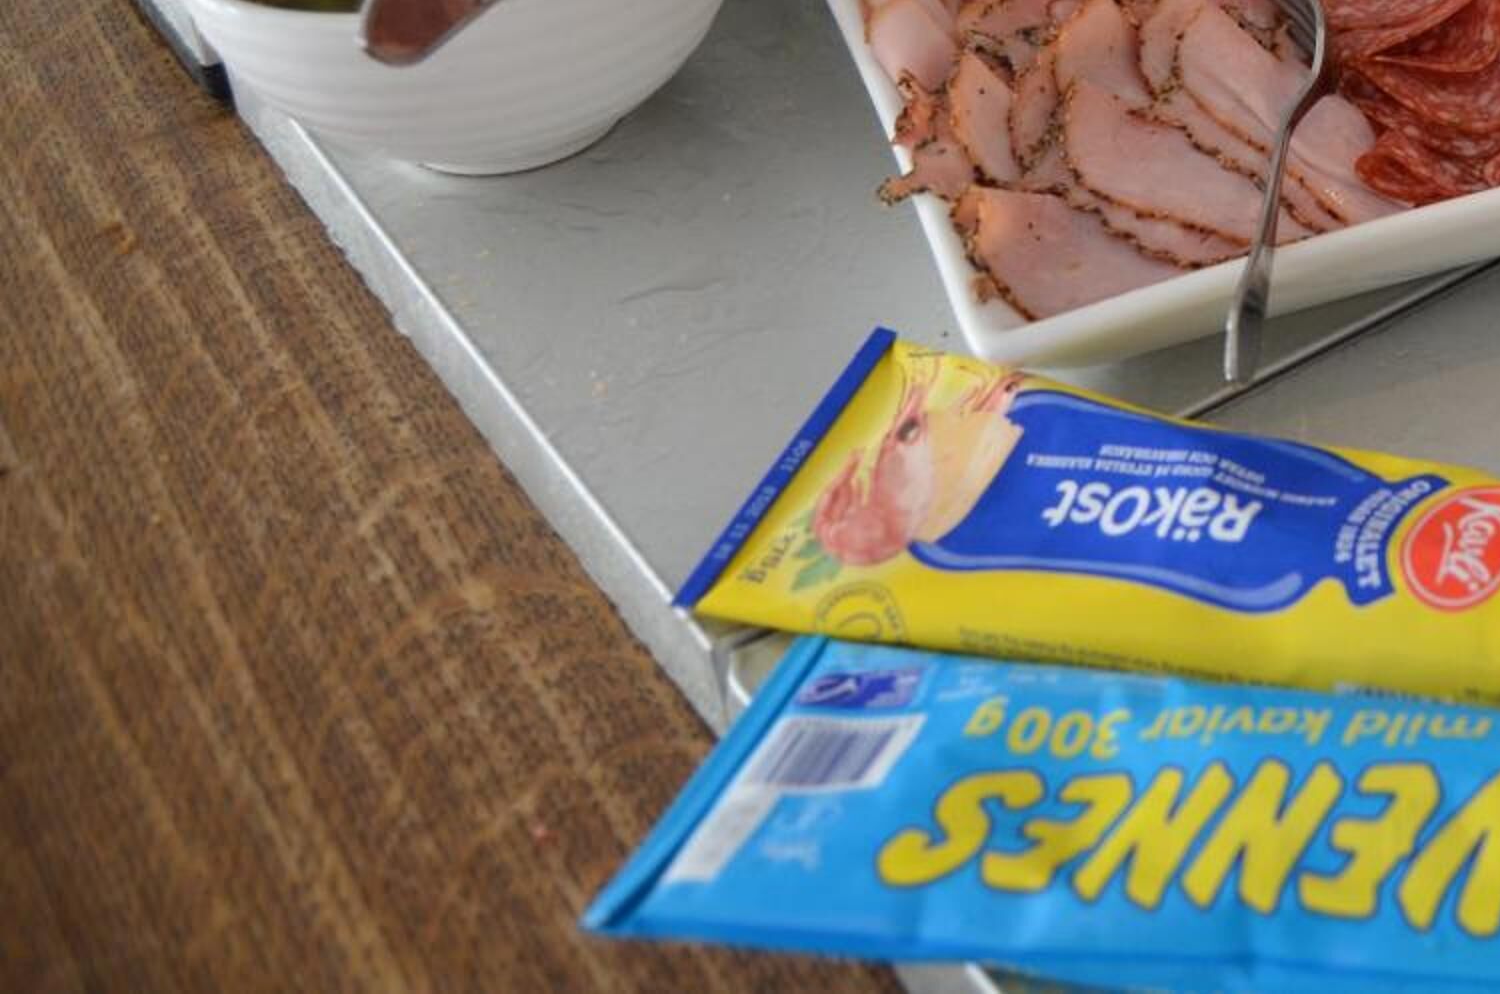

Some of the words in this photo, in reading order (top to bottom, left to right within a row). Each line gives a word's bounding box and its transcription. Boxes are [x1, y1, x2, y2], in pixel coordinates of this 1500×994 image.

[1041, 478, 1263, 543] RäkOst
[1354, 480, 1432, 588] ORIGINALET
[1138, 703, 1334, 746] kaviar
[1340, 707, 1496, 746] mild
